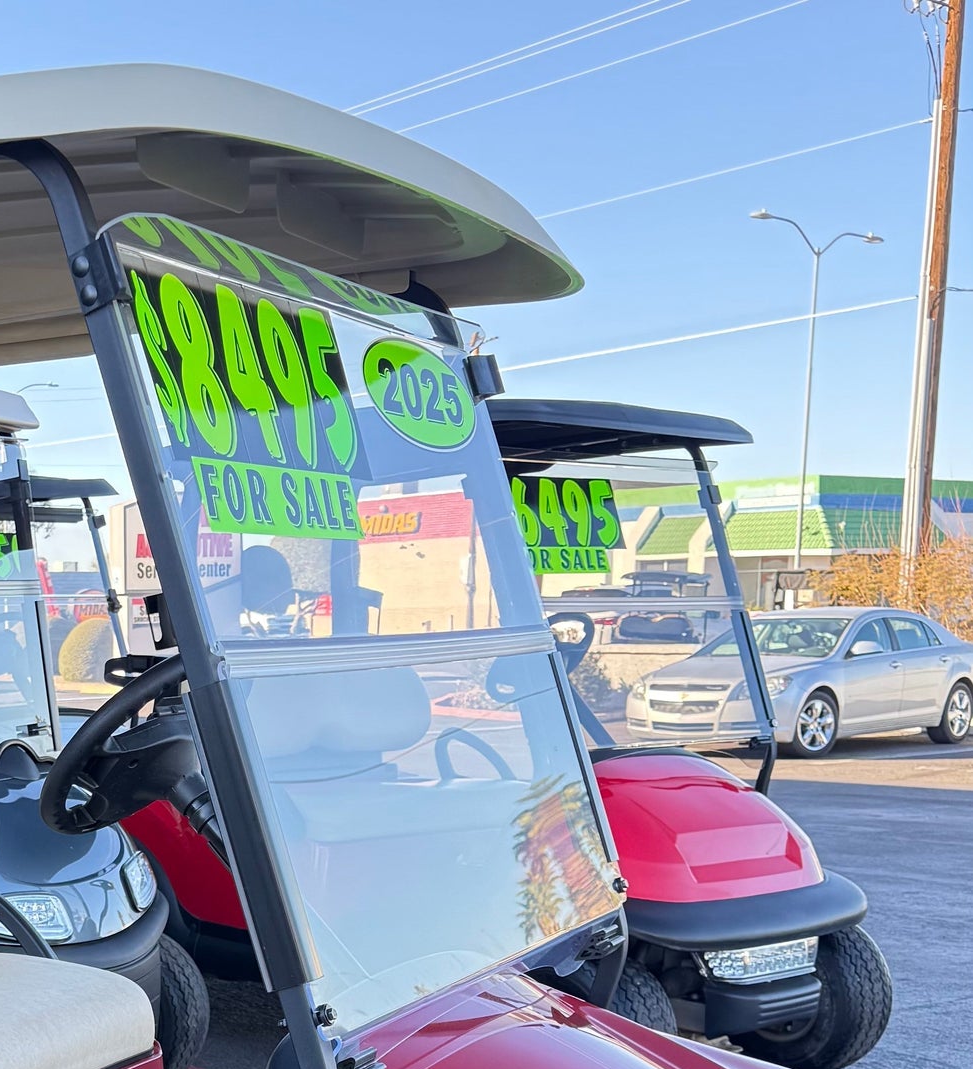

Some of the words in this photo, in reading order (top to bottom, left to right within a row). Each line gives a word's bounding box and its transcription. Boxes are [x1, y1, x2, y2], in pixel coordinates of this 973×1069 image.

[130, 269, 358, 473] $8495
[377, 357, 465, 427] 2025
[200, 464, 275, 525] FOR
[280, 472, 359, 530] SALE
[361, 512, 422, 536] MIDAS
[560, 548, 608, 571] SALE
